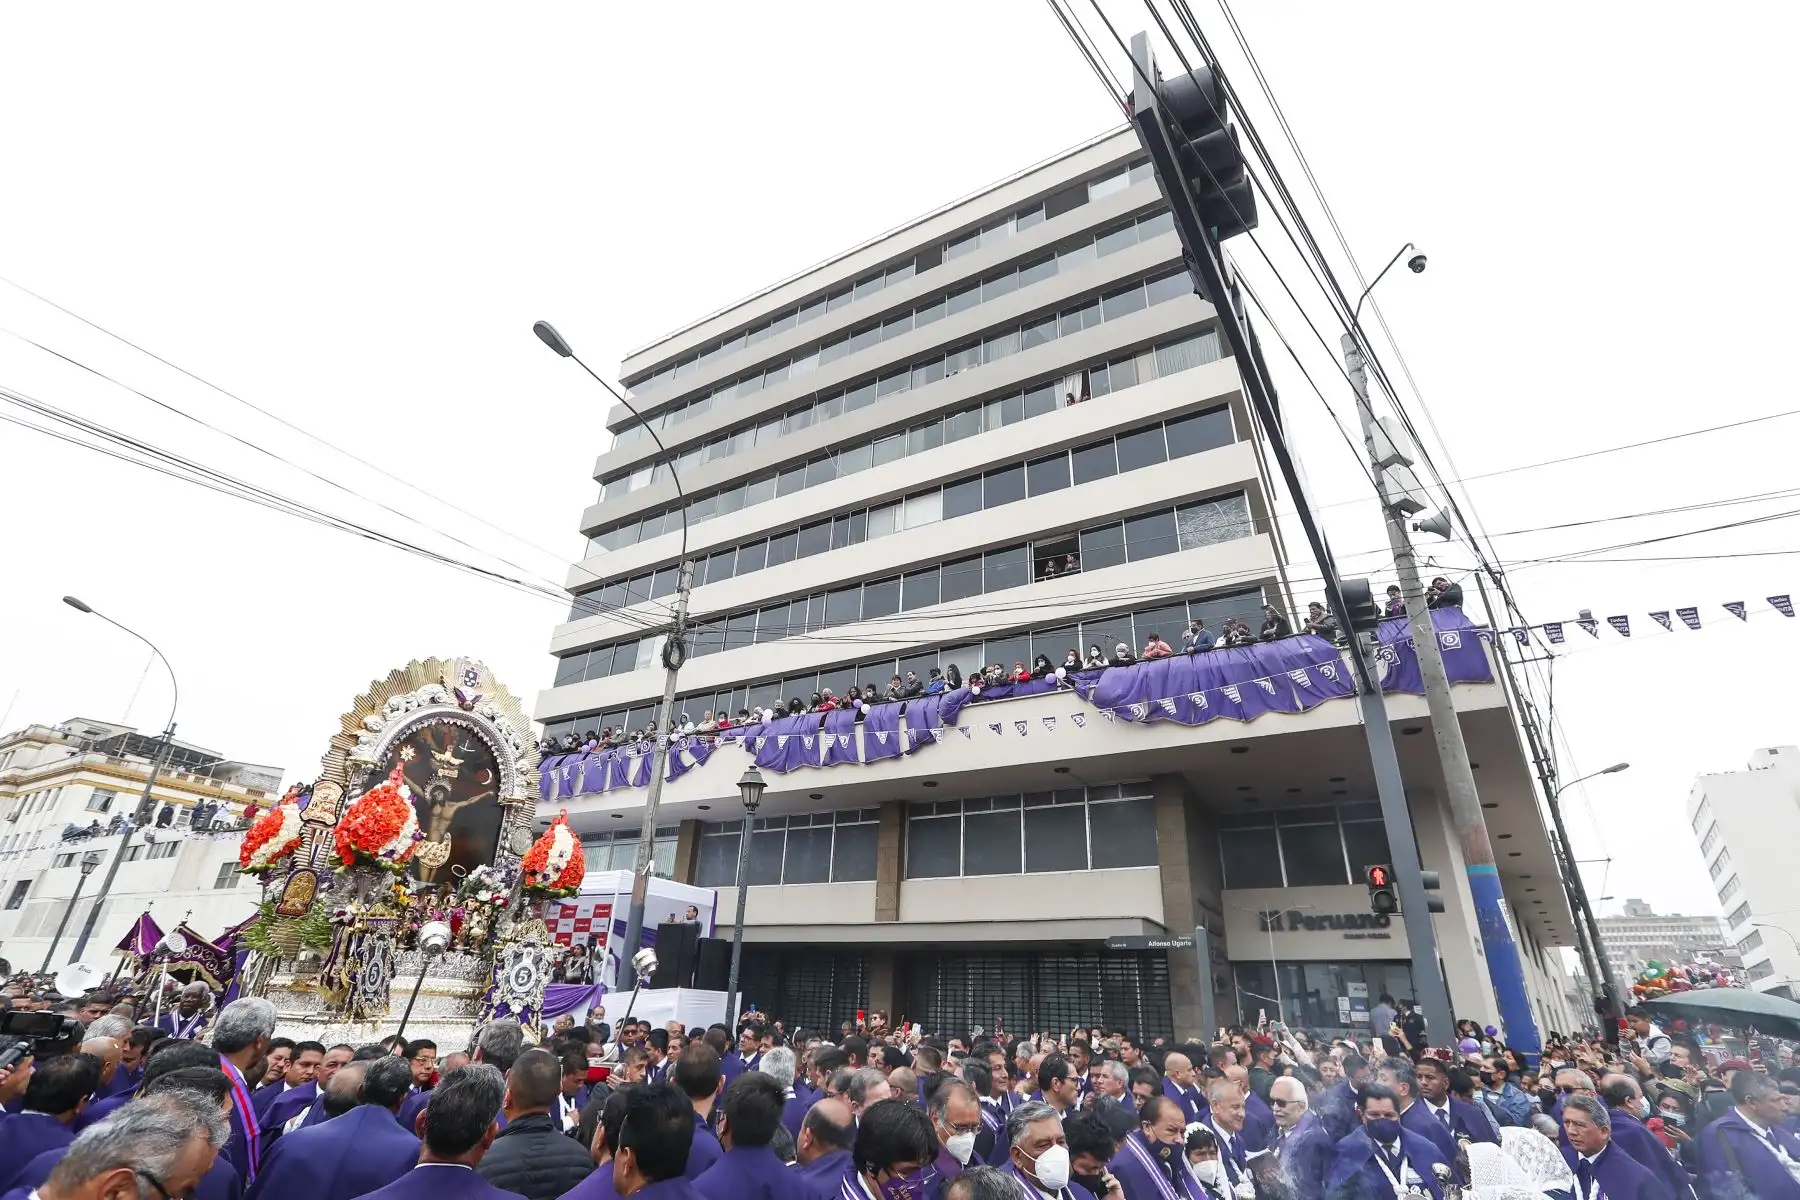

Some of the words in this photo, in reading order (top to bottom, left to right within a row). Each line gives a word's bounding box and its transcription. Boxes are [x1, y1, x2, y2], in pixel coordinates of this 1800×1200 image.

[1286, 909, 1391, 932] Peruano
[1171, 940, 1192, 948] Ugarte
[369, 966, 379, 983] 5
[517, 969, 529, 985] 5
